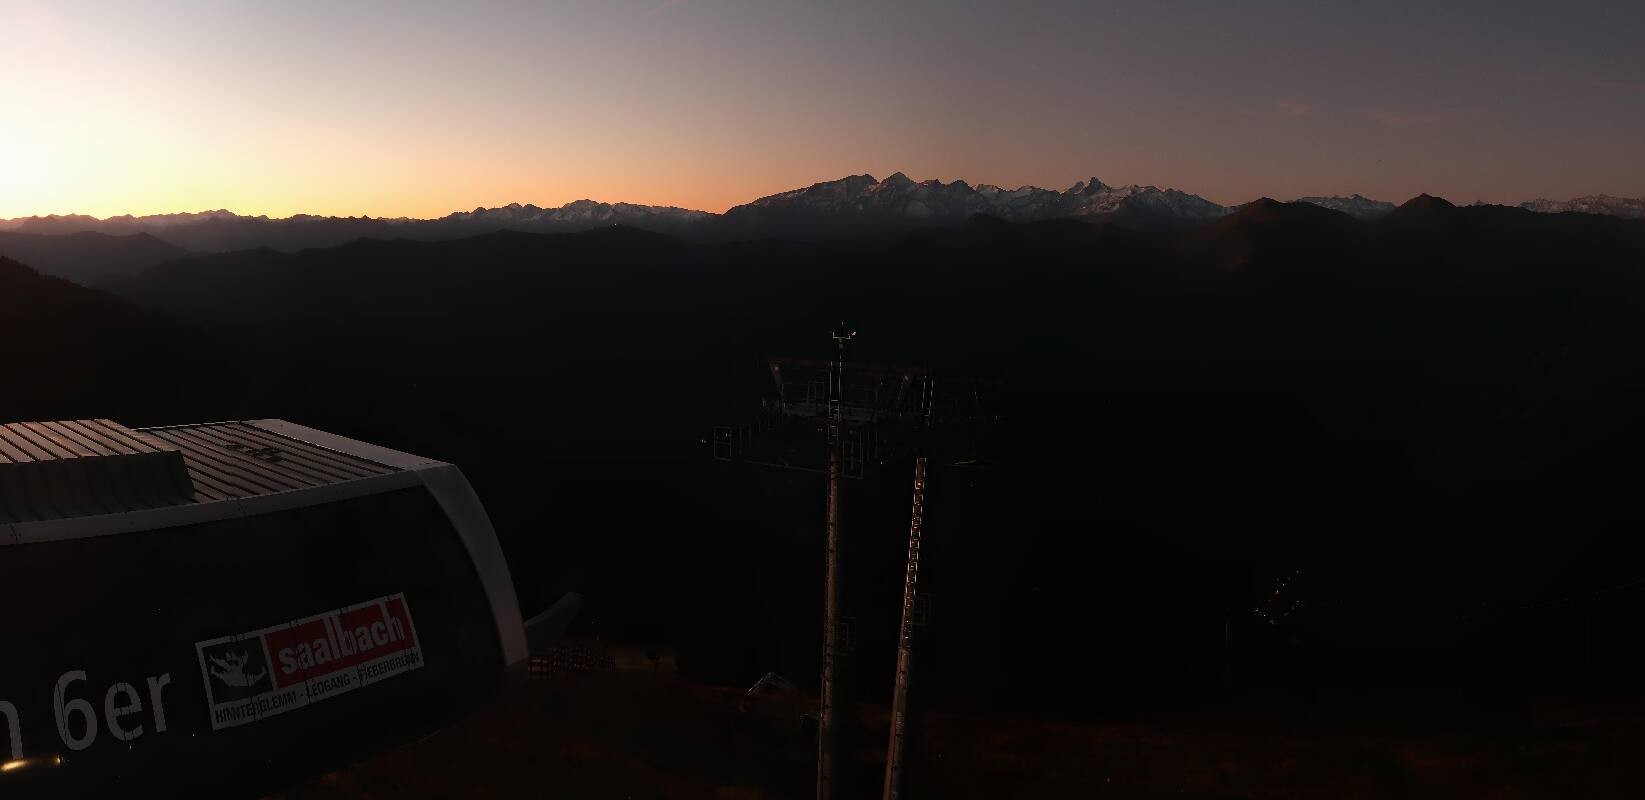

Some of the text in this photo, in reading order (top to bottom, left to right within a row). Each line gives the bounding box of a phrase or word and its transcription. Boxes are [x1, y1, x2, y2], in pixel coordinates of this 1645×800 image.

[278, 602, 406, 675] saalbach
[53, 667, 172, 751] 6er
[305, 673, 350, 699] LEOGANG
